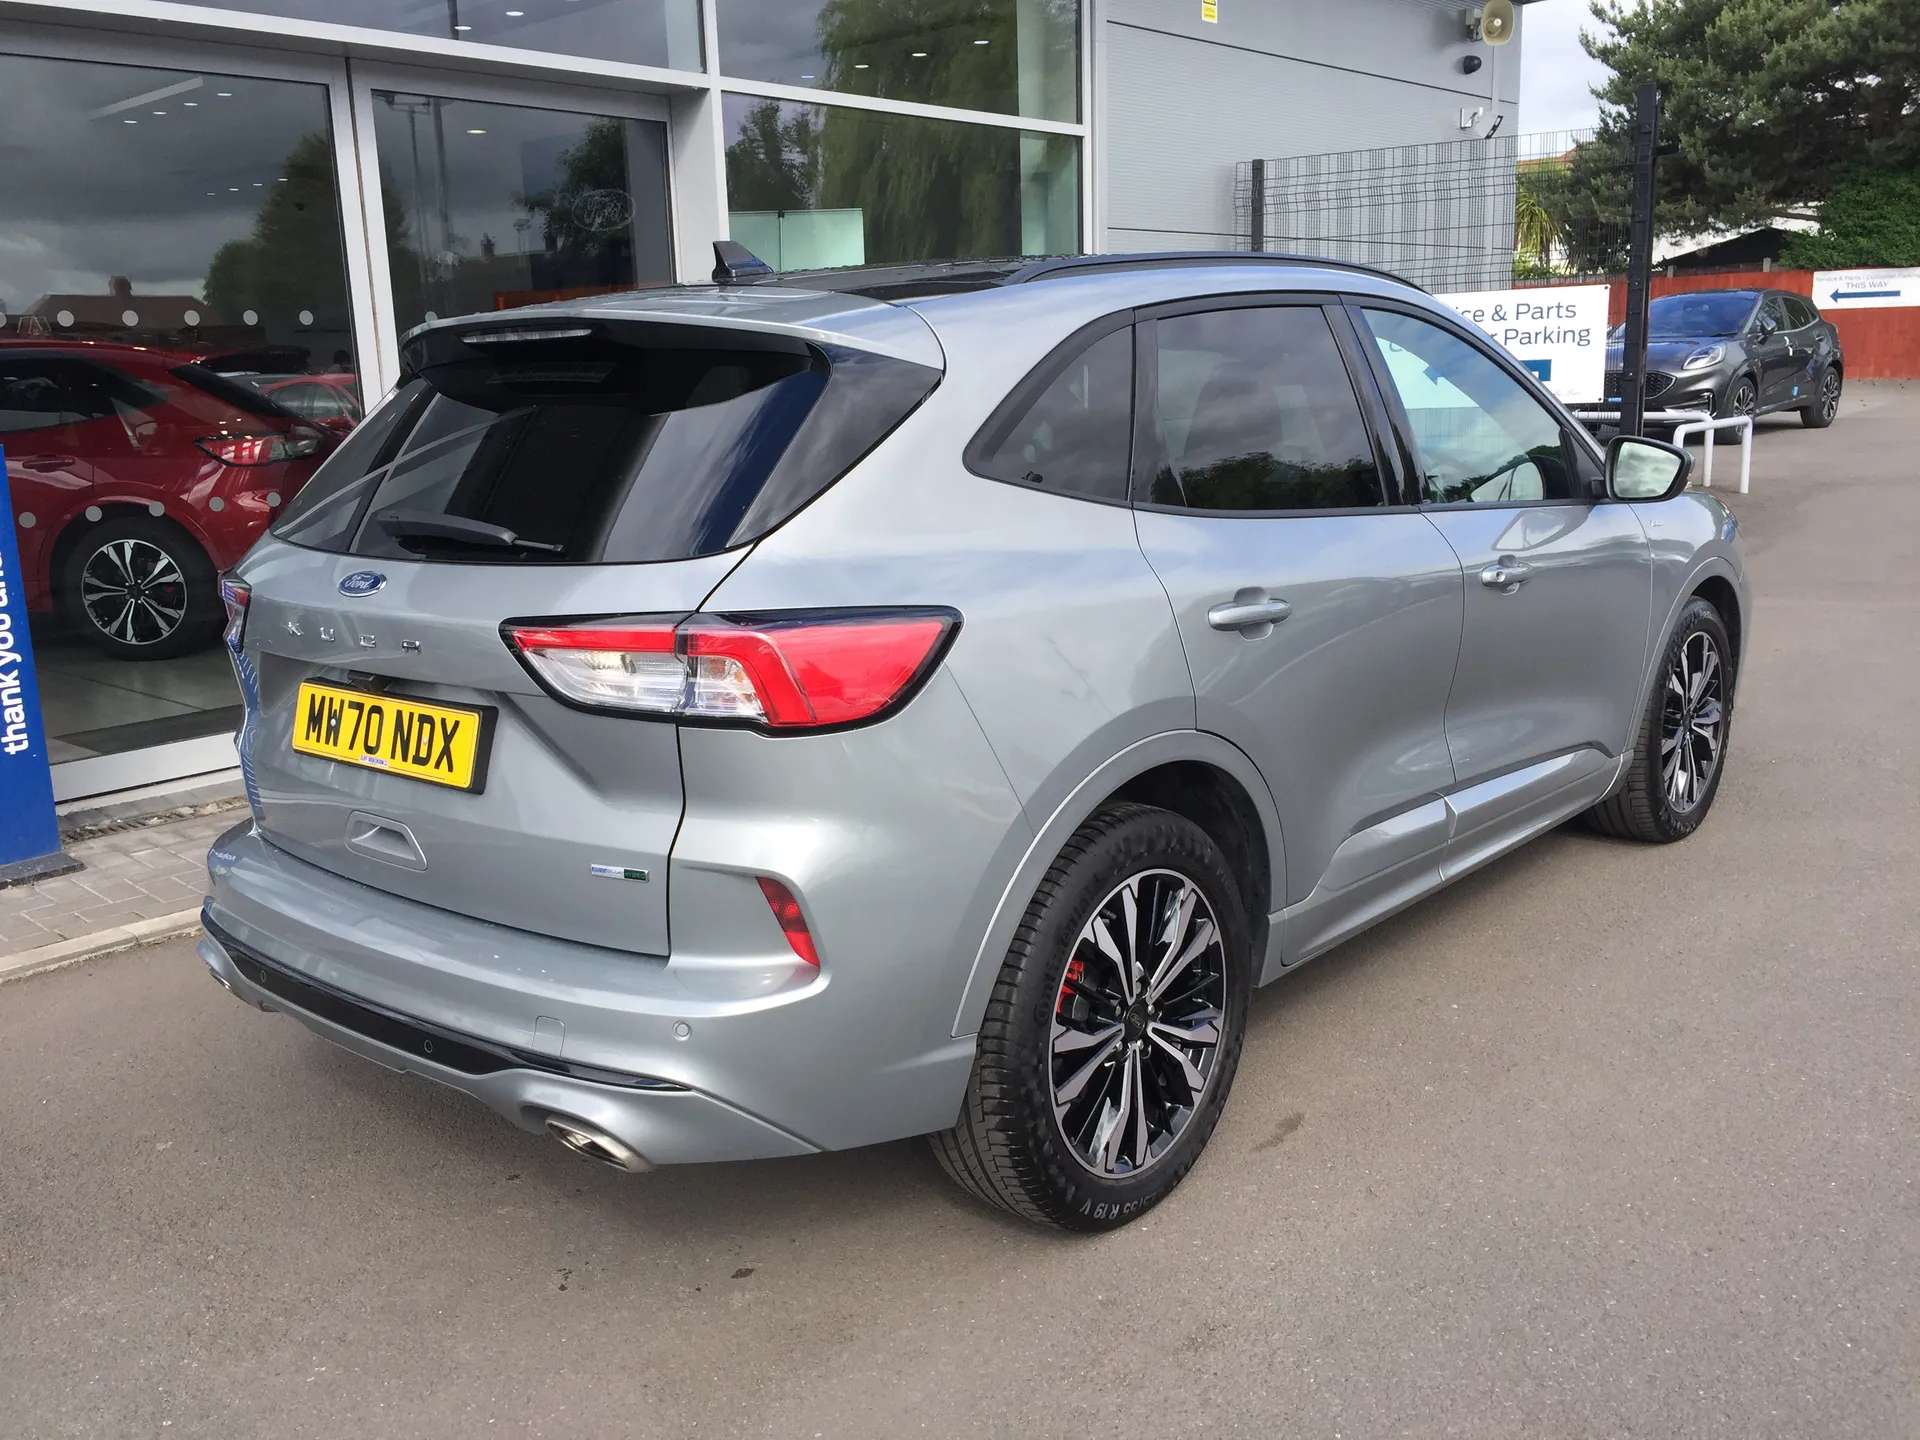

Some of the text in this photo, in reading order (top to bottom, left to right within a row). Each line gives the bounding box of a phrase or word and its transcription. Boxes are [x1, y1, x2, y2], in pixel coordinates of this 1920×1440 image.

[1846, 281, 1889, 289] THIS WAY
[1491, 304, 1508, 322] &
[1515, 302, 1577, 321] Parts
[1504, 326, 1591, 347] Parking
[344, 574, 375, 590] Ford
[0, 613, 28, 755] thank you
[305, 693, 461, 773] MW70 NDX
